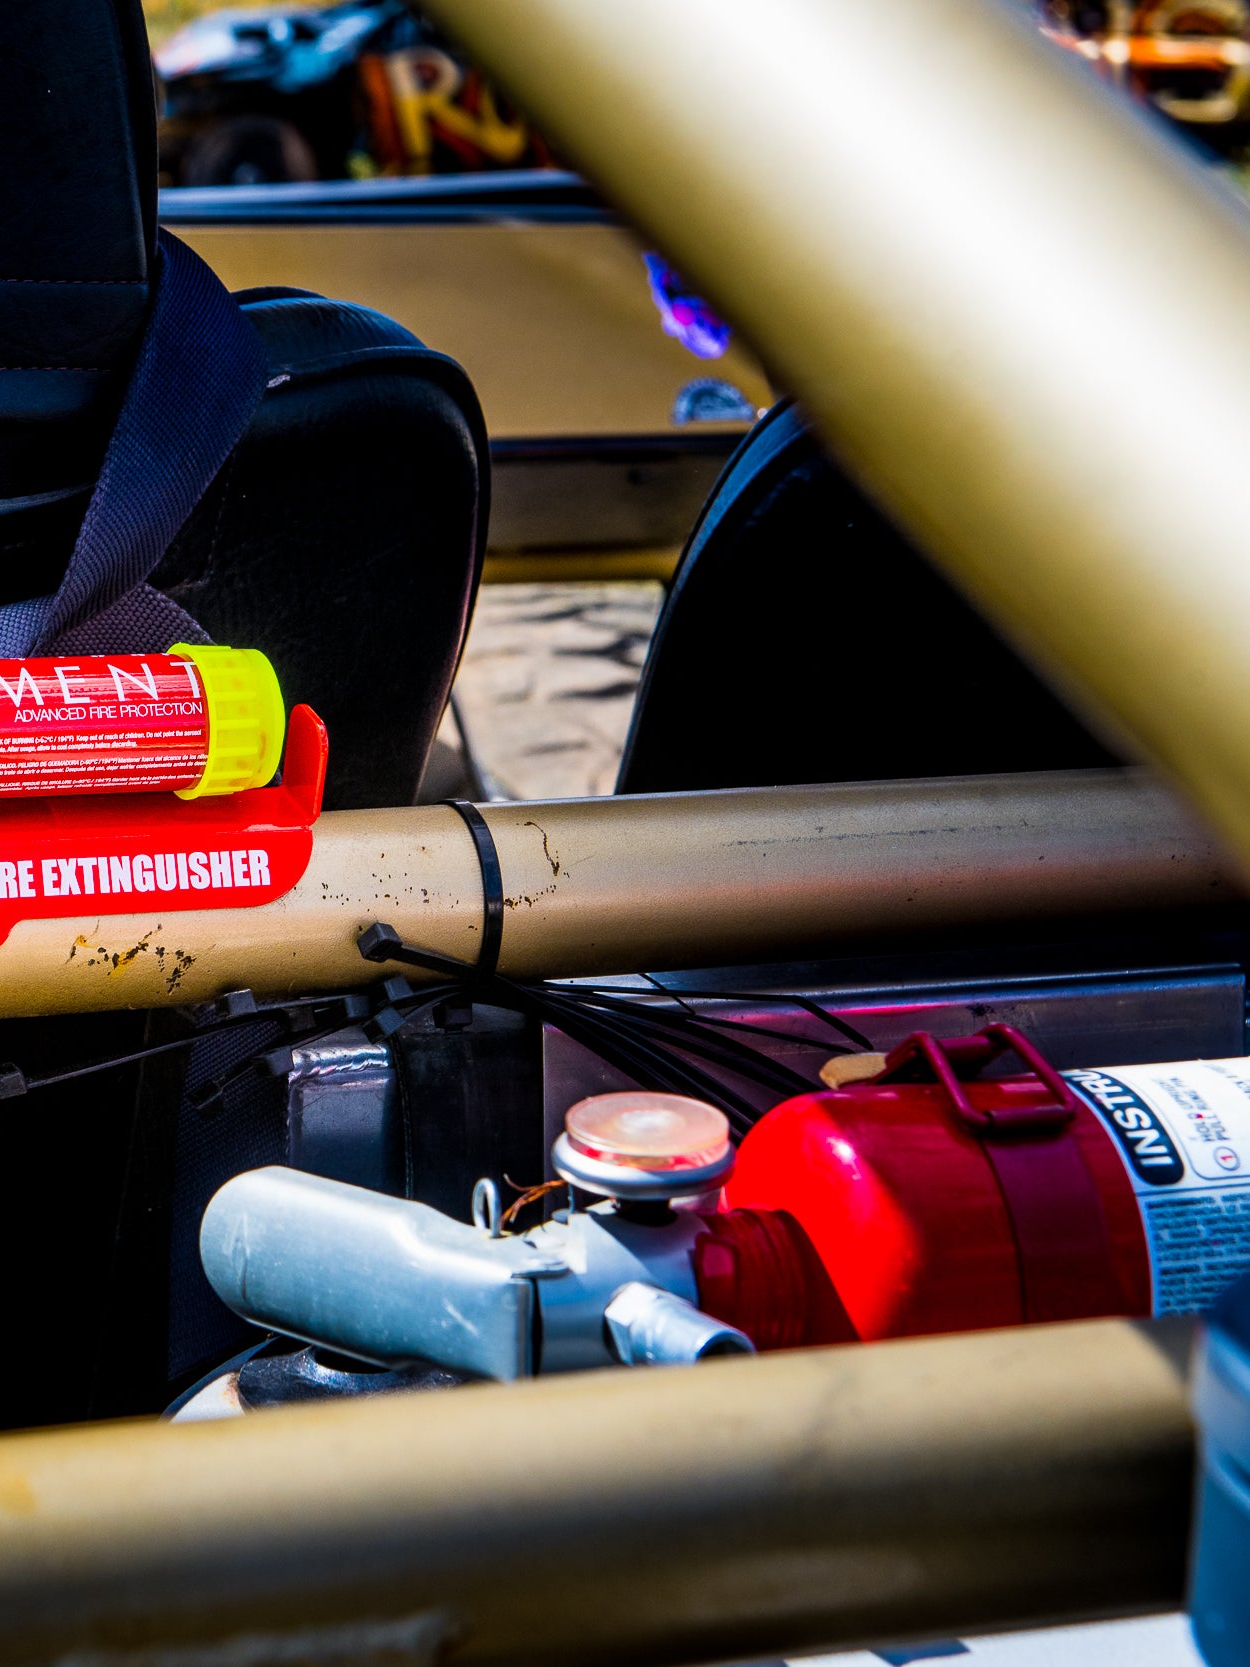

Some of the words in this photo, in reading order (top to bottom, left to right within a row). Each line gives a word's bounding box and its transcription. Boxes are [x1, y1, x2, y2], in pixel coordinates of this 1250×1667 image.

[14, 707, 86, 723] ADVANCED
[89, 705, 117, 720] FIRE
[120, 701, 203, 718] PROTECTION
[4, 737, 11, 745] OF
[163, 730, 175, 738] point
[41, 849, 271, 897] EXTINGUISHER
